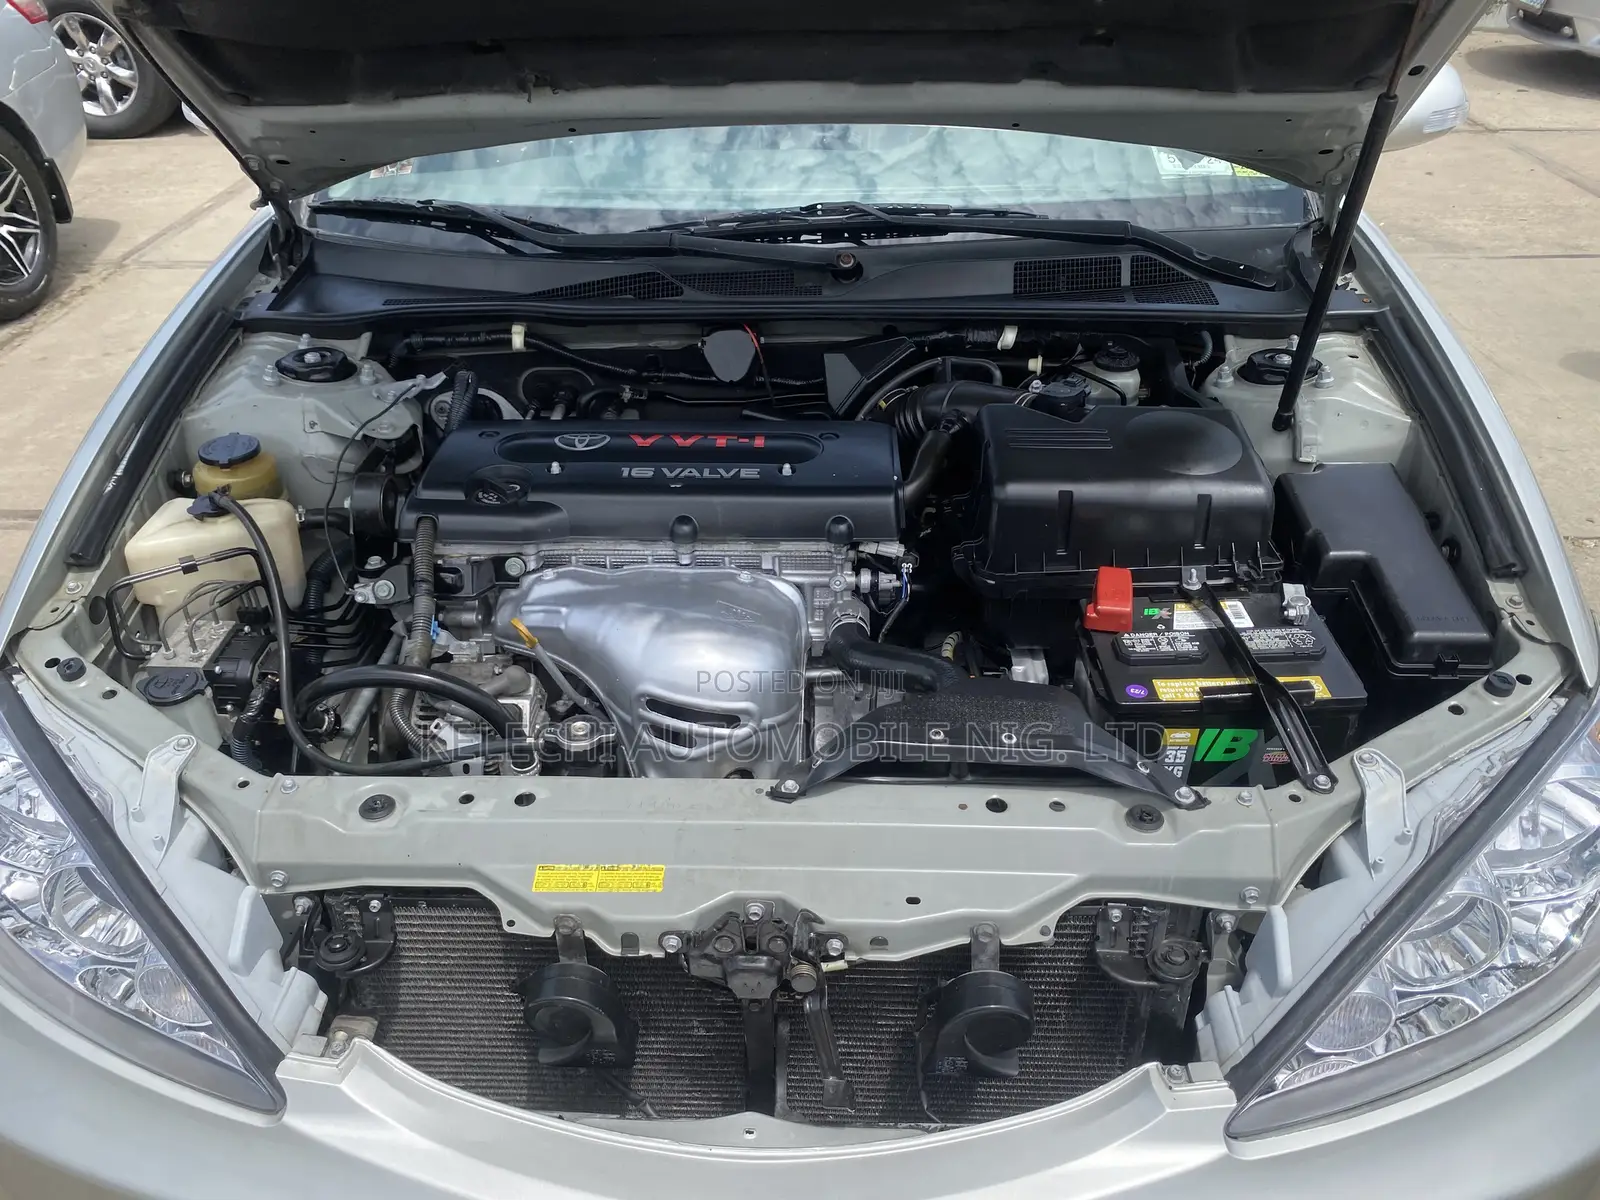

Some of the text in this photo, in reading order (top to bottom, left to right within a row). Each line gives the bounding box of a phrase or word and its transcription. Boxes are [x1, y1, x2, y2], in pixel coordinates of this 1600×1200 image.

[621, 466, 760, 479] 16 VALVE
[1164, 750, 1187, 763] 35
